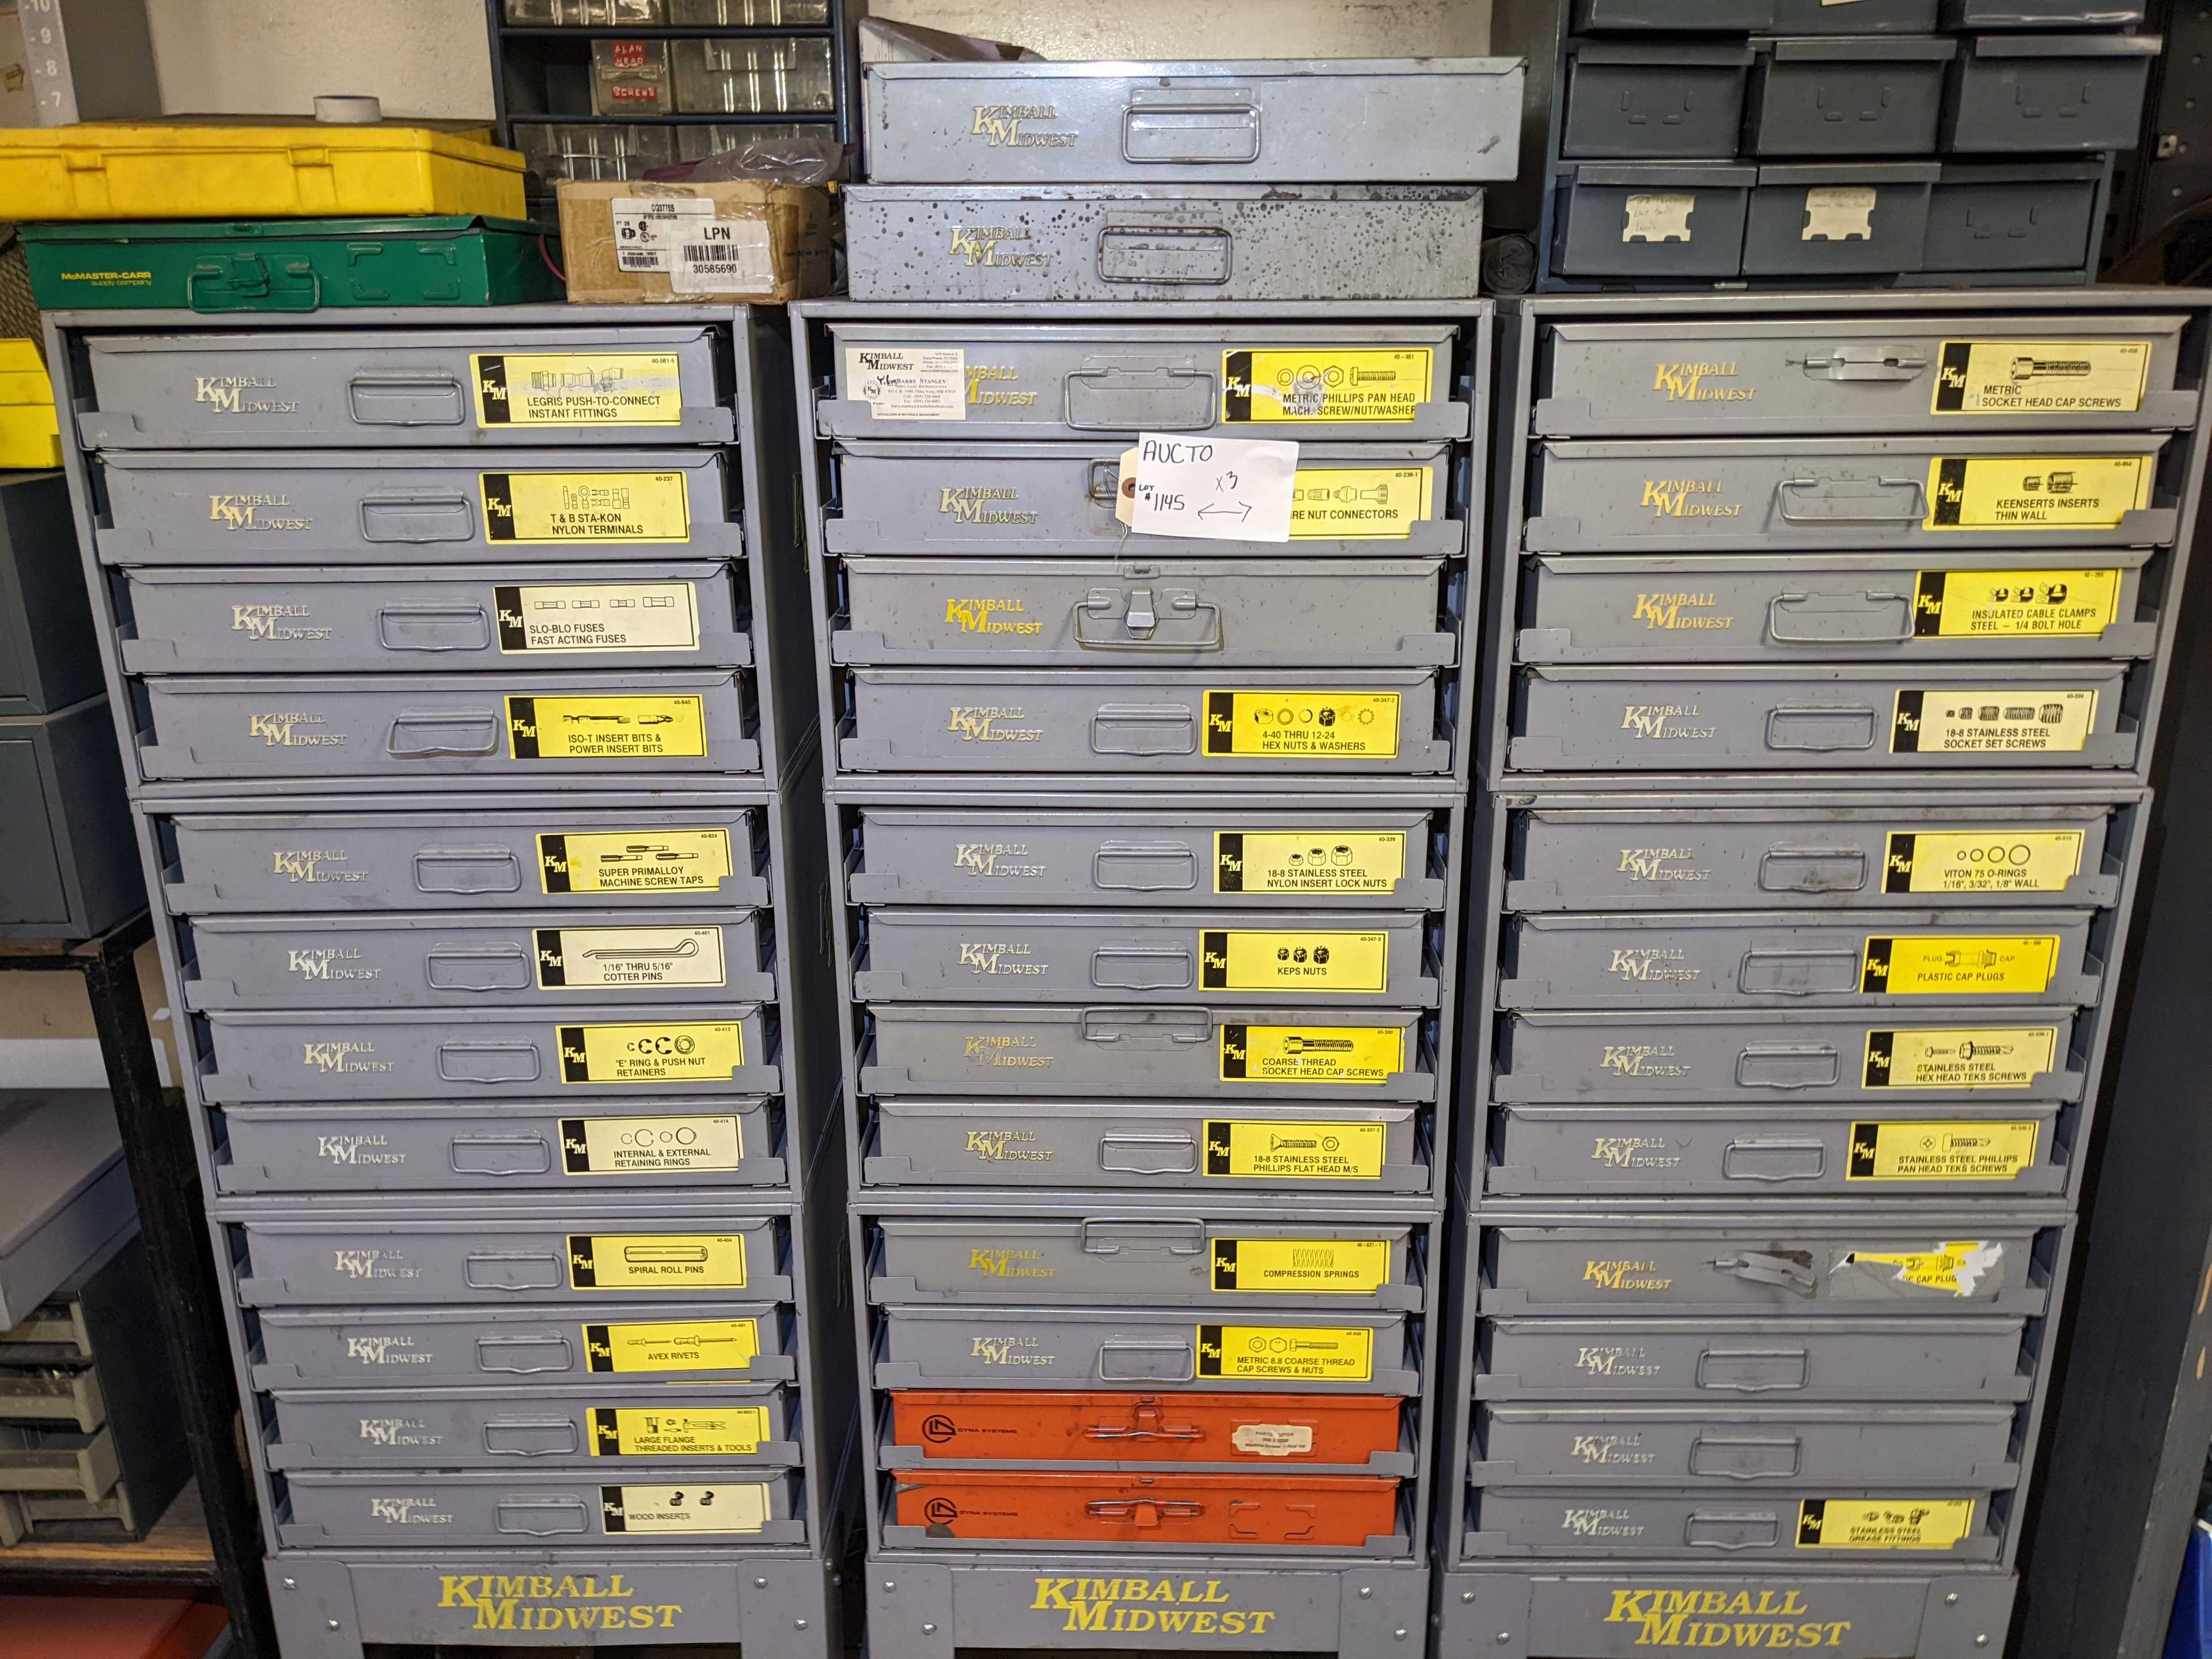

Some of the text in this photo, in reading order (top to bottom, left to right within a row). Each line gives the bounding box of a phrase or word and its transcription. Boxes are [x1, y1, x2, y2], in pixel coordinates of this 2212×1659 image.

[40, 28, 51, 44] 9
[615, 45, 642, 54] ALAN
[46, 59, 57, 75] 8
[613, 86, 654, 97] SCREWS
[51, 92, 60, 108] 7
[971, 106, 1056, 134] KIMBALL
[988, 119, 1077, 146] MIDWEST
[704, 228, 730, 240] LPN
[693, 264, 737, 273] 30585690
[859, 353, 903, 363] KIMBALL
[867, 360, 914, 370] MIDWEST
[1652, 363, 1737, 391] KIMBALL
[1668, 376, 1756, 402] MIDWEST
[528, 396, 660, 406] LEGRIS PUSH-TO-CONNECT
[1283, 393, 1415, 403] METRIC PHILLIPS PAN HEAD
[1982, 399, 2121, 407] SOCKET HEAD CAP SCREWS
[529, 408, 618, 418] INSTANT FITTINGS
[1143, 441, 1213, 463] AUCTO
[1154, 494, 1184, 511] 1145
[1997, 499, 2099, 508] KEENSERTS INSERTS
[1308, 510, 1398, 519] NUT CONNECTORS
[1995, 511, 2047, 520] THIN WALL
[552, 525, 643, 534] NYLON TERMINALS
[945, 599, 1024, 622] KIMBALL
[1972, 609, 2096, 619] INSULATED CABLE CLAMPS
[961, 611, 1043, 634] MIDWEST
[1971, 620, 2081, 630] STEEL 1/4 BOLT HOLE
[530, 624, 604, 633] SLO-BLO FUSES
[531, 635, 626, 645] FAST ACTING FUSES
[643, 744, 663, 752] BITS
[632, 868, 683, 876] PRIMALLOY
[1945, 870, 1972, 878] VITON
[600, 878, 642, 887] MACHINE
[645, 877, 678, 885] SCREW
[1918, 973, 2004, 981] PLASTIC CAP PLUGS
[617, 1069, 666, 1077] RETAINERS
[1916, 1072, 2027, 1082] HEX HEAD TEKS SCREWS
[667, 1149, 711, 1157] EXTERNAL
[615, 1159, 661, 1167] RETAINING
[437, 1575, 634, 1607] KIMBALL
[1029, 1578, 1230, 1609] KIMBALL
[1604, 1590, 1808, 1622] KIMBALL
[472, 1598, 683, 1630] MIDWEST
[1063, 1600, 1275, 1634] MIDWEST
[1635, 1613, 1850, 1647] MIDWEST
